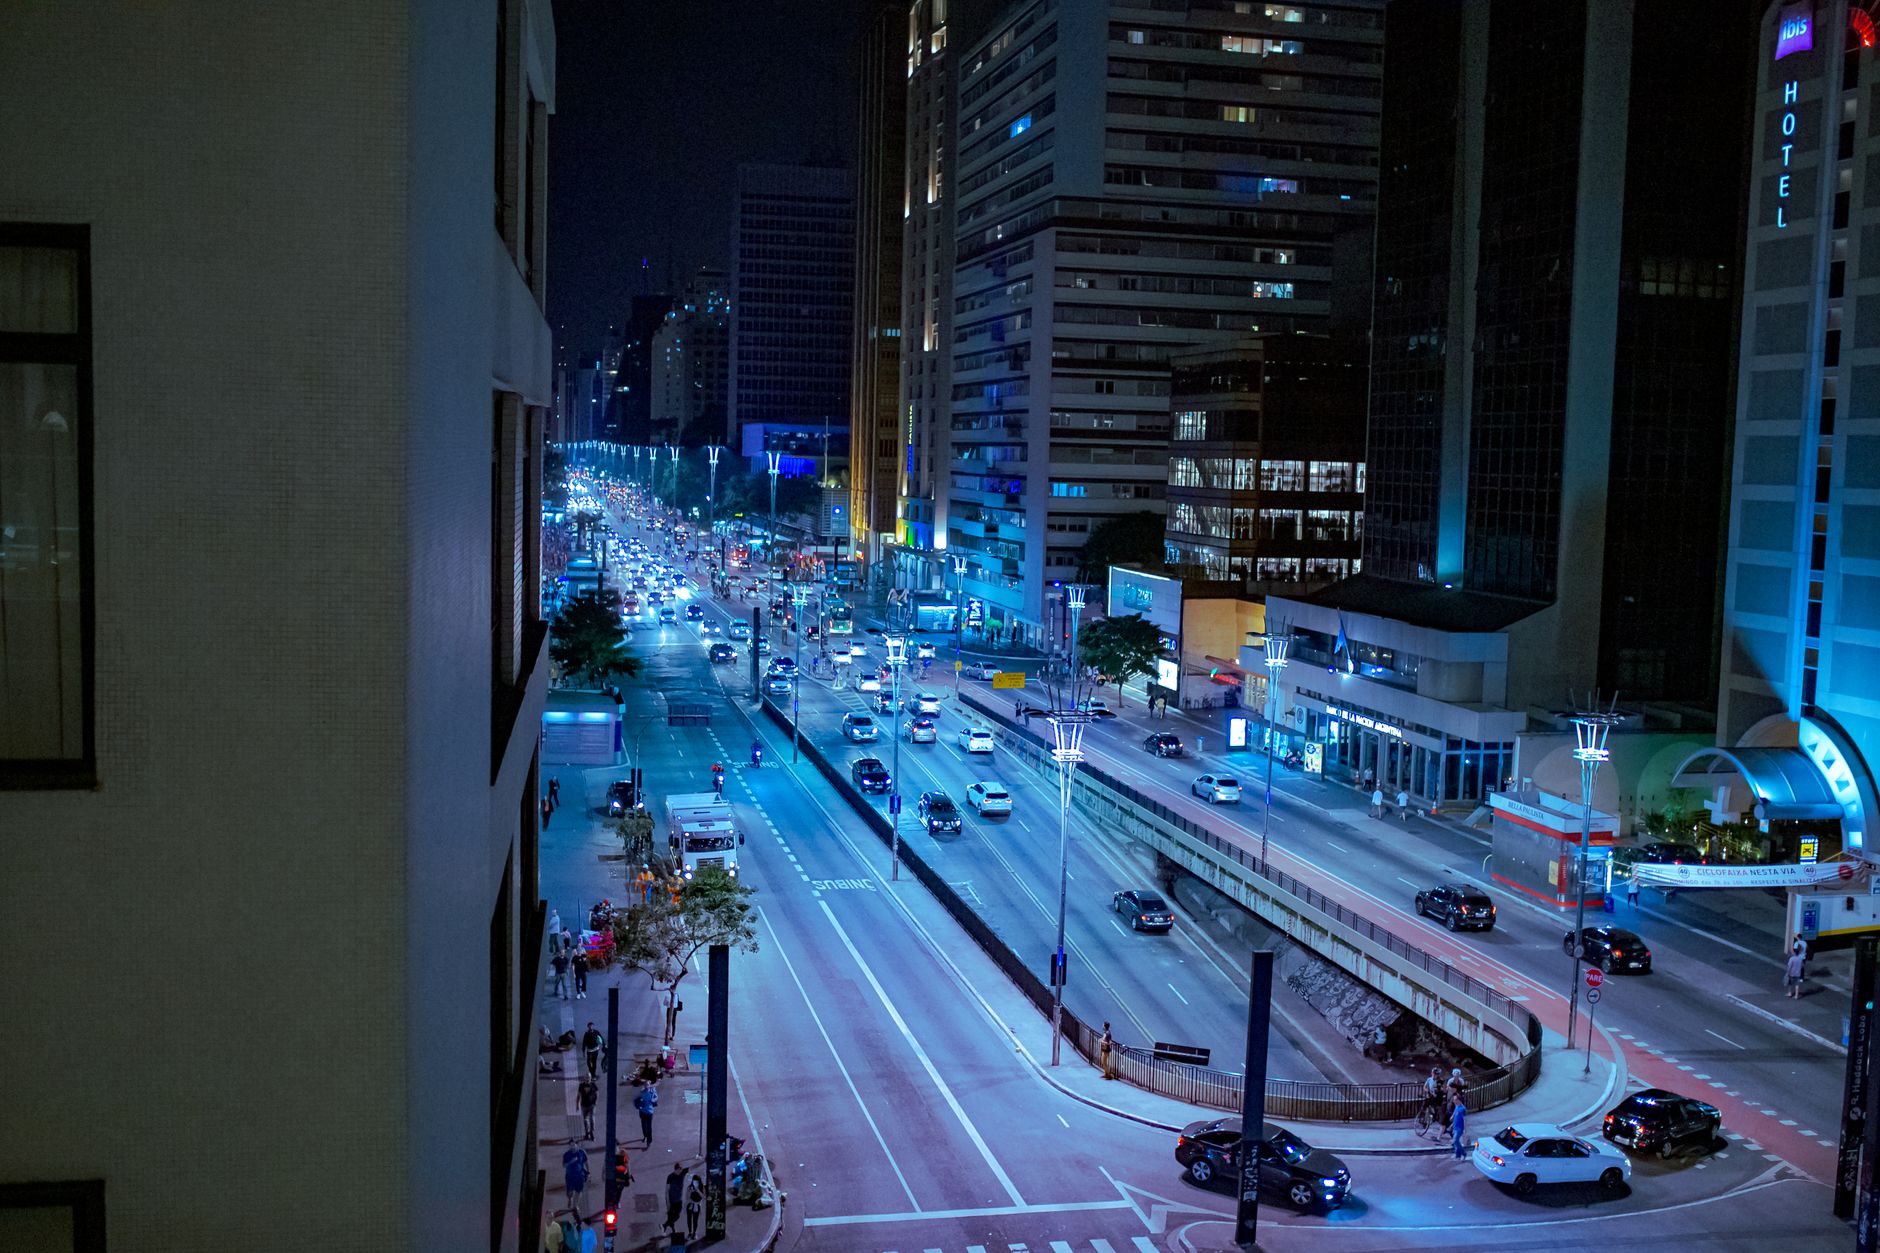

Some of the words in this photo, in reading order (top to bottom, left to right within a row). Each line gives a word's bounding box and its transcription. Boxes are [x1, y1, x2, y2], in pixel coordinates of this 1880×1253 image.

[1782, 18, 1808, 40] ibis
[1777, 80, 1798, 229] HOTEL
[1697, 868, 1748, 877] CICLOFAIXA
[1750, 868, 1778, 876] NESTA
[1779, 867, 1796, 875] VIA
[1585, 973, 1602, 983] PARE
[1856, 1015, 1867, 1041] Lobo
[1853, 1045, 1864, 1093] Haddock
